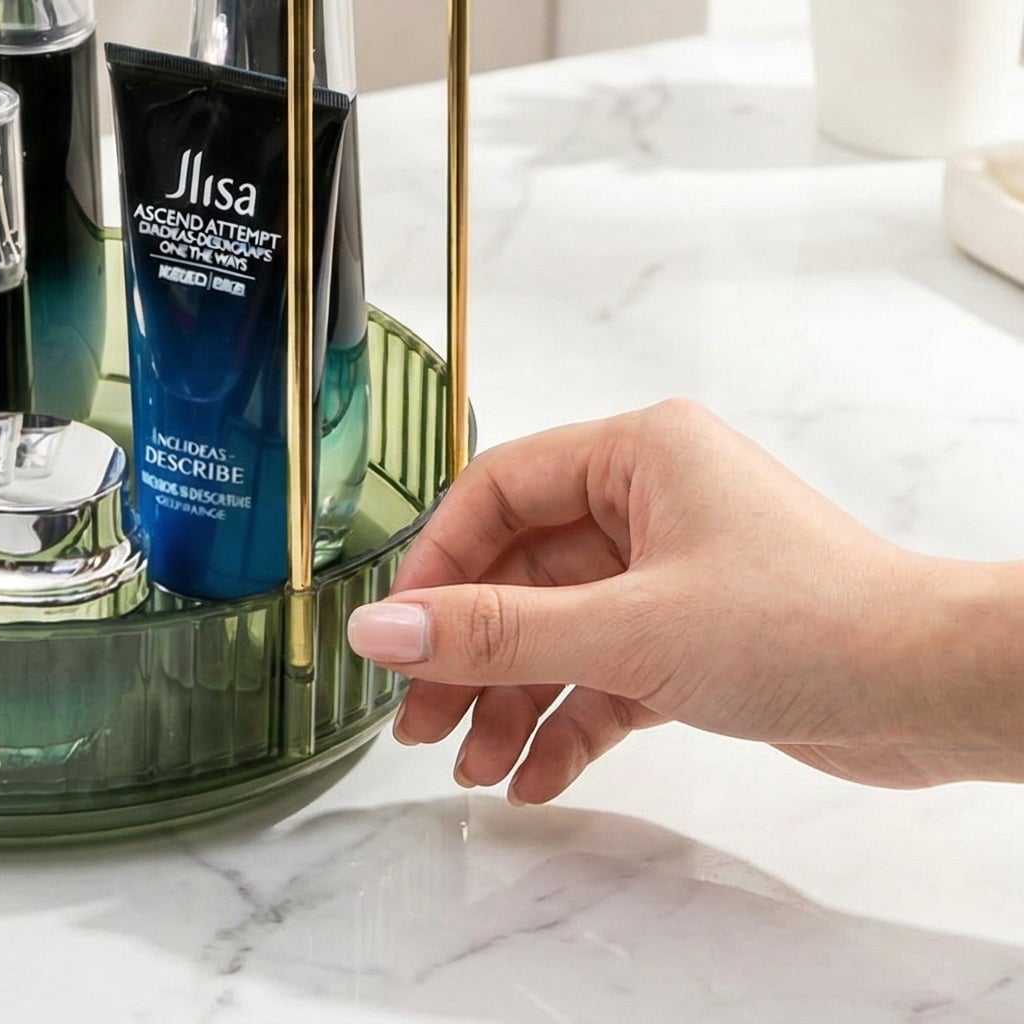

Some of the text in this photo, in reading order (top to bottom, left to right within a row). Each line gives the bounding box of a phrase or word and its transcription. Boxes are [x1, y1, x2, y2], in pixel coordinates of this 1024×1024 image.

[133, 203, 204, 232] ASCEND
[205, 218, 282, 250] ATTEMPT
[145, 445, 245, 485] DESCRIBE
